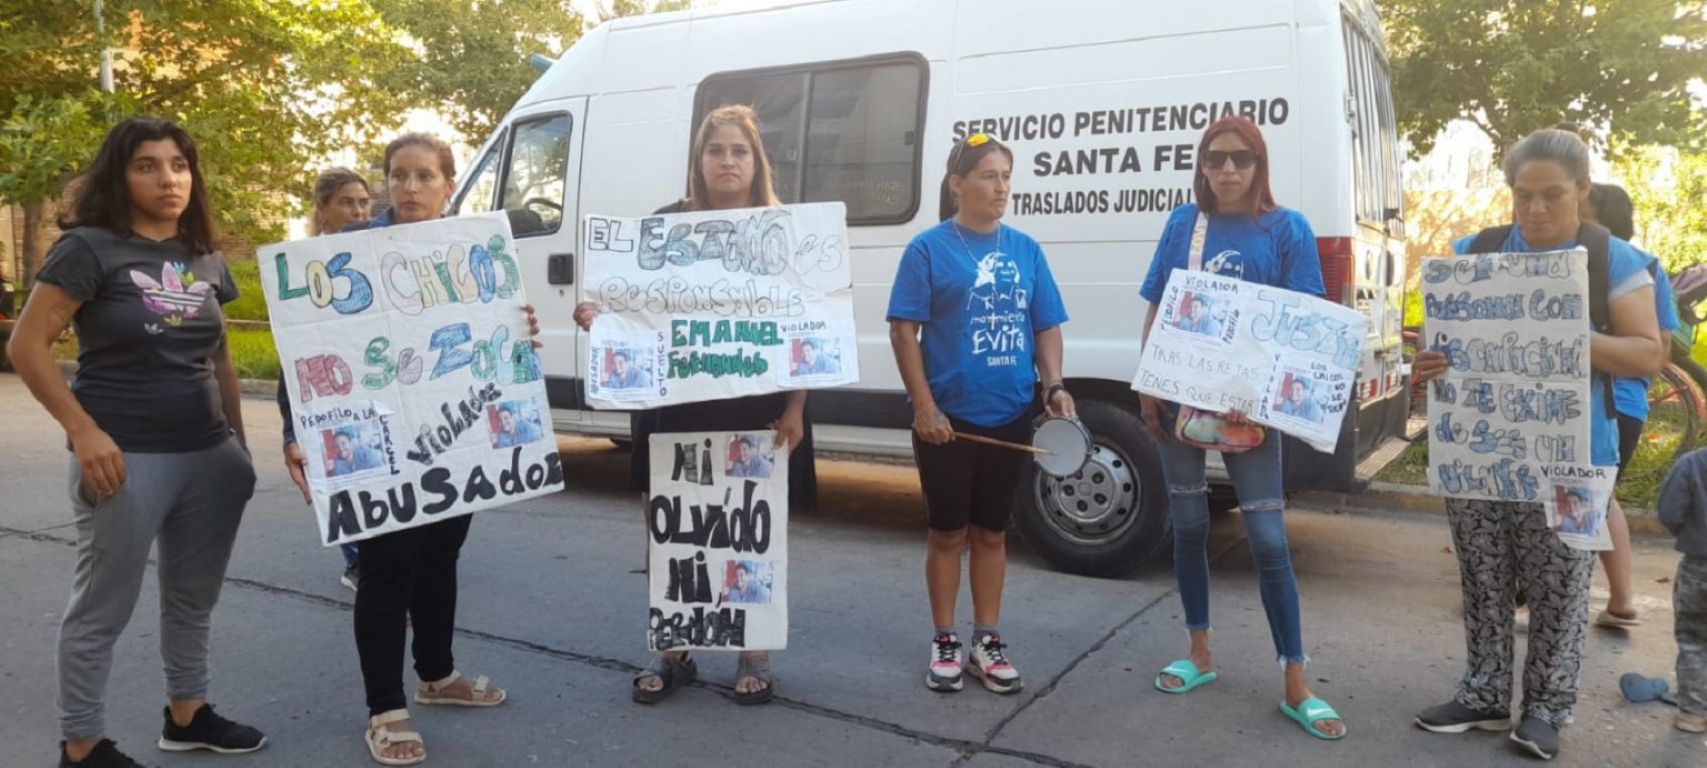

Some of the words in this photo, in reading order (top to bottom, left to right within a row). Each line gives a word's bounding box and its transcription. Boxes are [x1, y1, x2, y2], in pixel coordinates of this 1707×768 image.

[952, 113, 1065, 143] SERVICIO
[1074, 97, 1289, 137] PENITENCIARIO
[1033, 146, 1141, 177] SANTA
[1153, 144, 1194, 171] FE
[1012, 189, 1109, 216] TRASLADOS
[589, 217, 633, 252] EL
[275, 251, 372, 314] LOS
[657, 331, 667, 397] SUELTO
[1152, 344, 1182, 366] TRAS
[1188, 356, 1213, 373] LAS
[295, 354, 353, 403] NO
[1140, 369, 1180, 395] TENES
[1186, 386, 1215, 404] QUE
[1334, 382, 1346, 391] NO
[353, 412, 361, 421] A
[362, 408, 375, 420] LA
[380, 415, 400, 475] CARCEL
